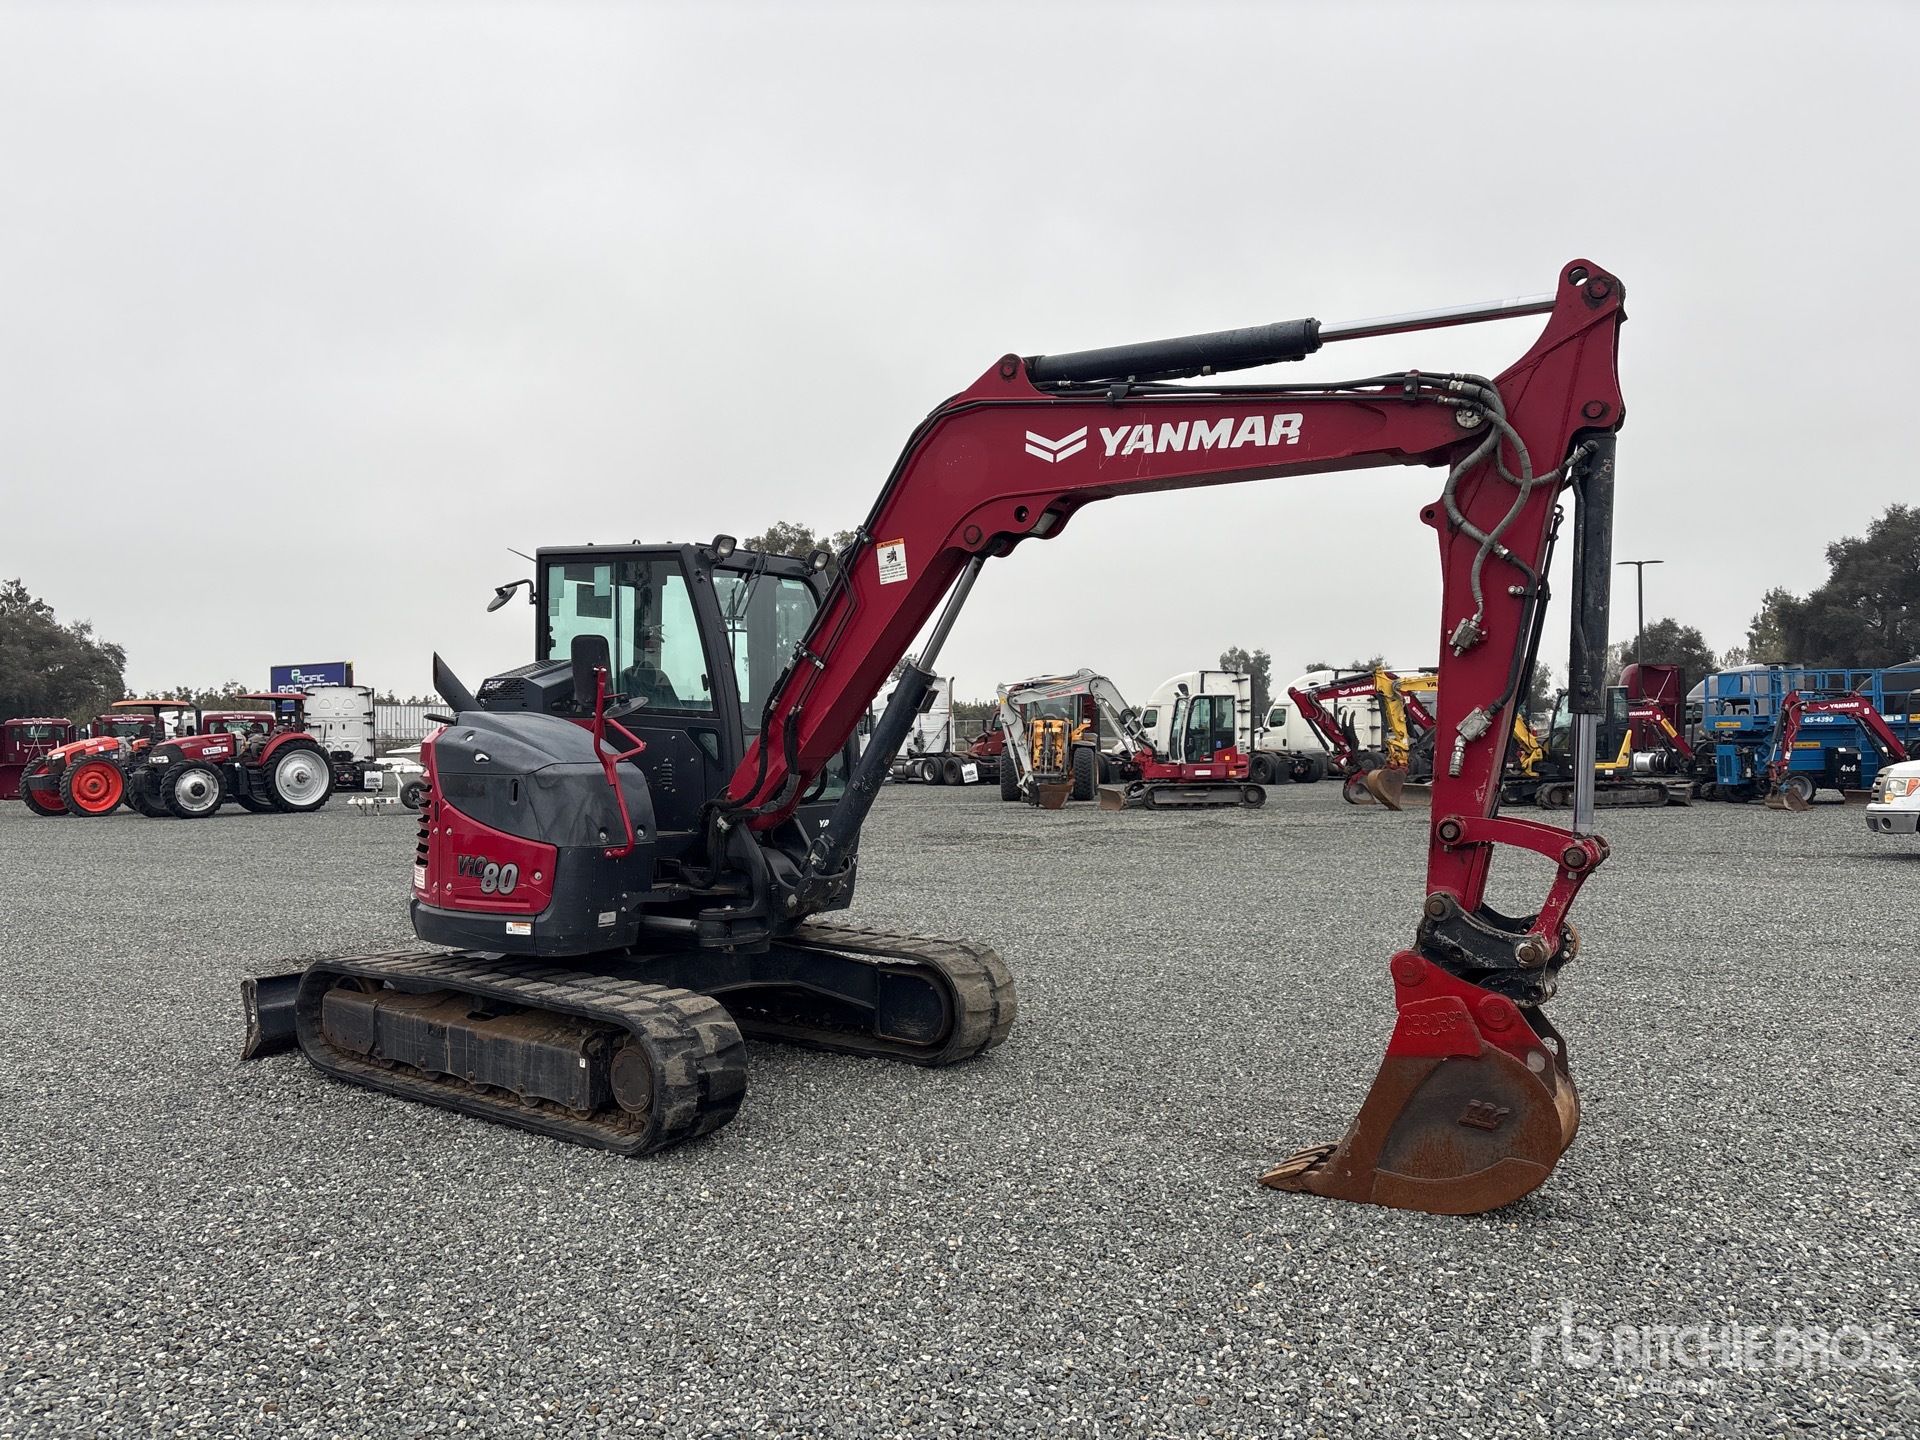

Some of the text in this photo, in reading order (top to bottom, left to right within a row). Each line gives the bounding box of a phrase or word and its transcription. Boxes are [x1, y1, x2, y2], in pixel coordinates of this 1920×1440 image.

[1099, 413, 1303, 456] YANMAR
[291, 669, 325, 683] PACIFIC
[1840, 764, 1856, 772] 4x4
